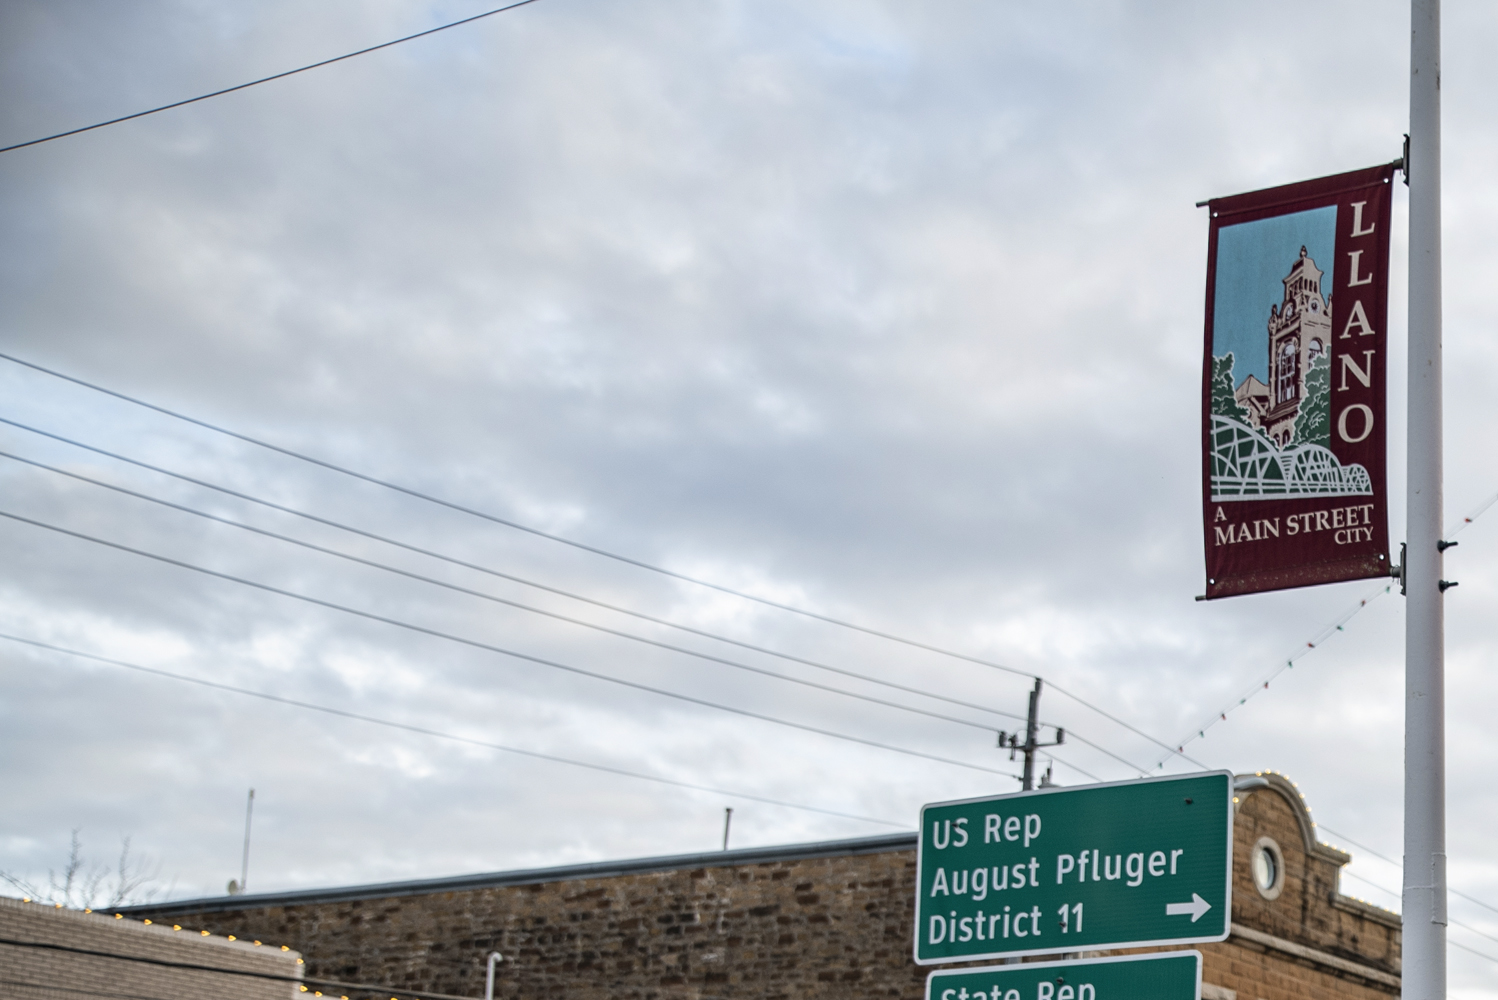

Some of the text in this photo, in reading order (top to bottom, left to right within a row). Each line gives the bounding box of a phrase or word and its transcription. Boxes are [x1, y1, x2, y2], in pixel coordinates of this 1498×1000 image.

[1337, 200, 1376, 444] LLANO
[1214, 505, 1227, 523] A
[1214, 503, 1375, 546] MAIN STREET
[1334, 526, 1375, 545] CITY
[932, 813, 1042, 850] US Rep
[930, 848, 1184, 902] August Pfluger
[928, 902, 1084, 946] District 11
